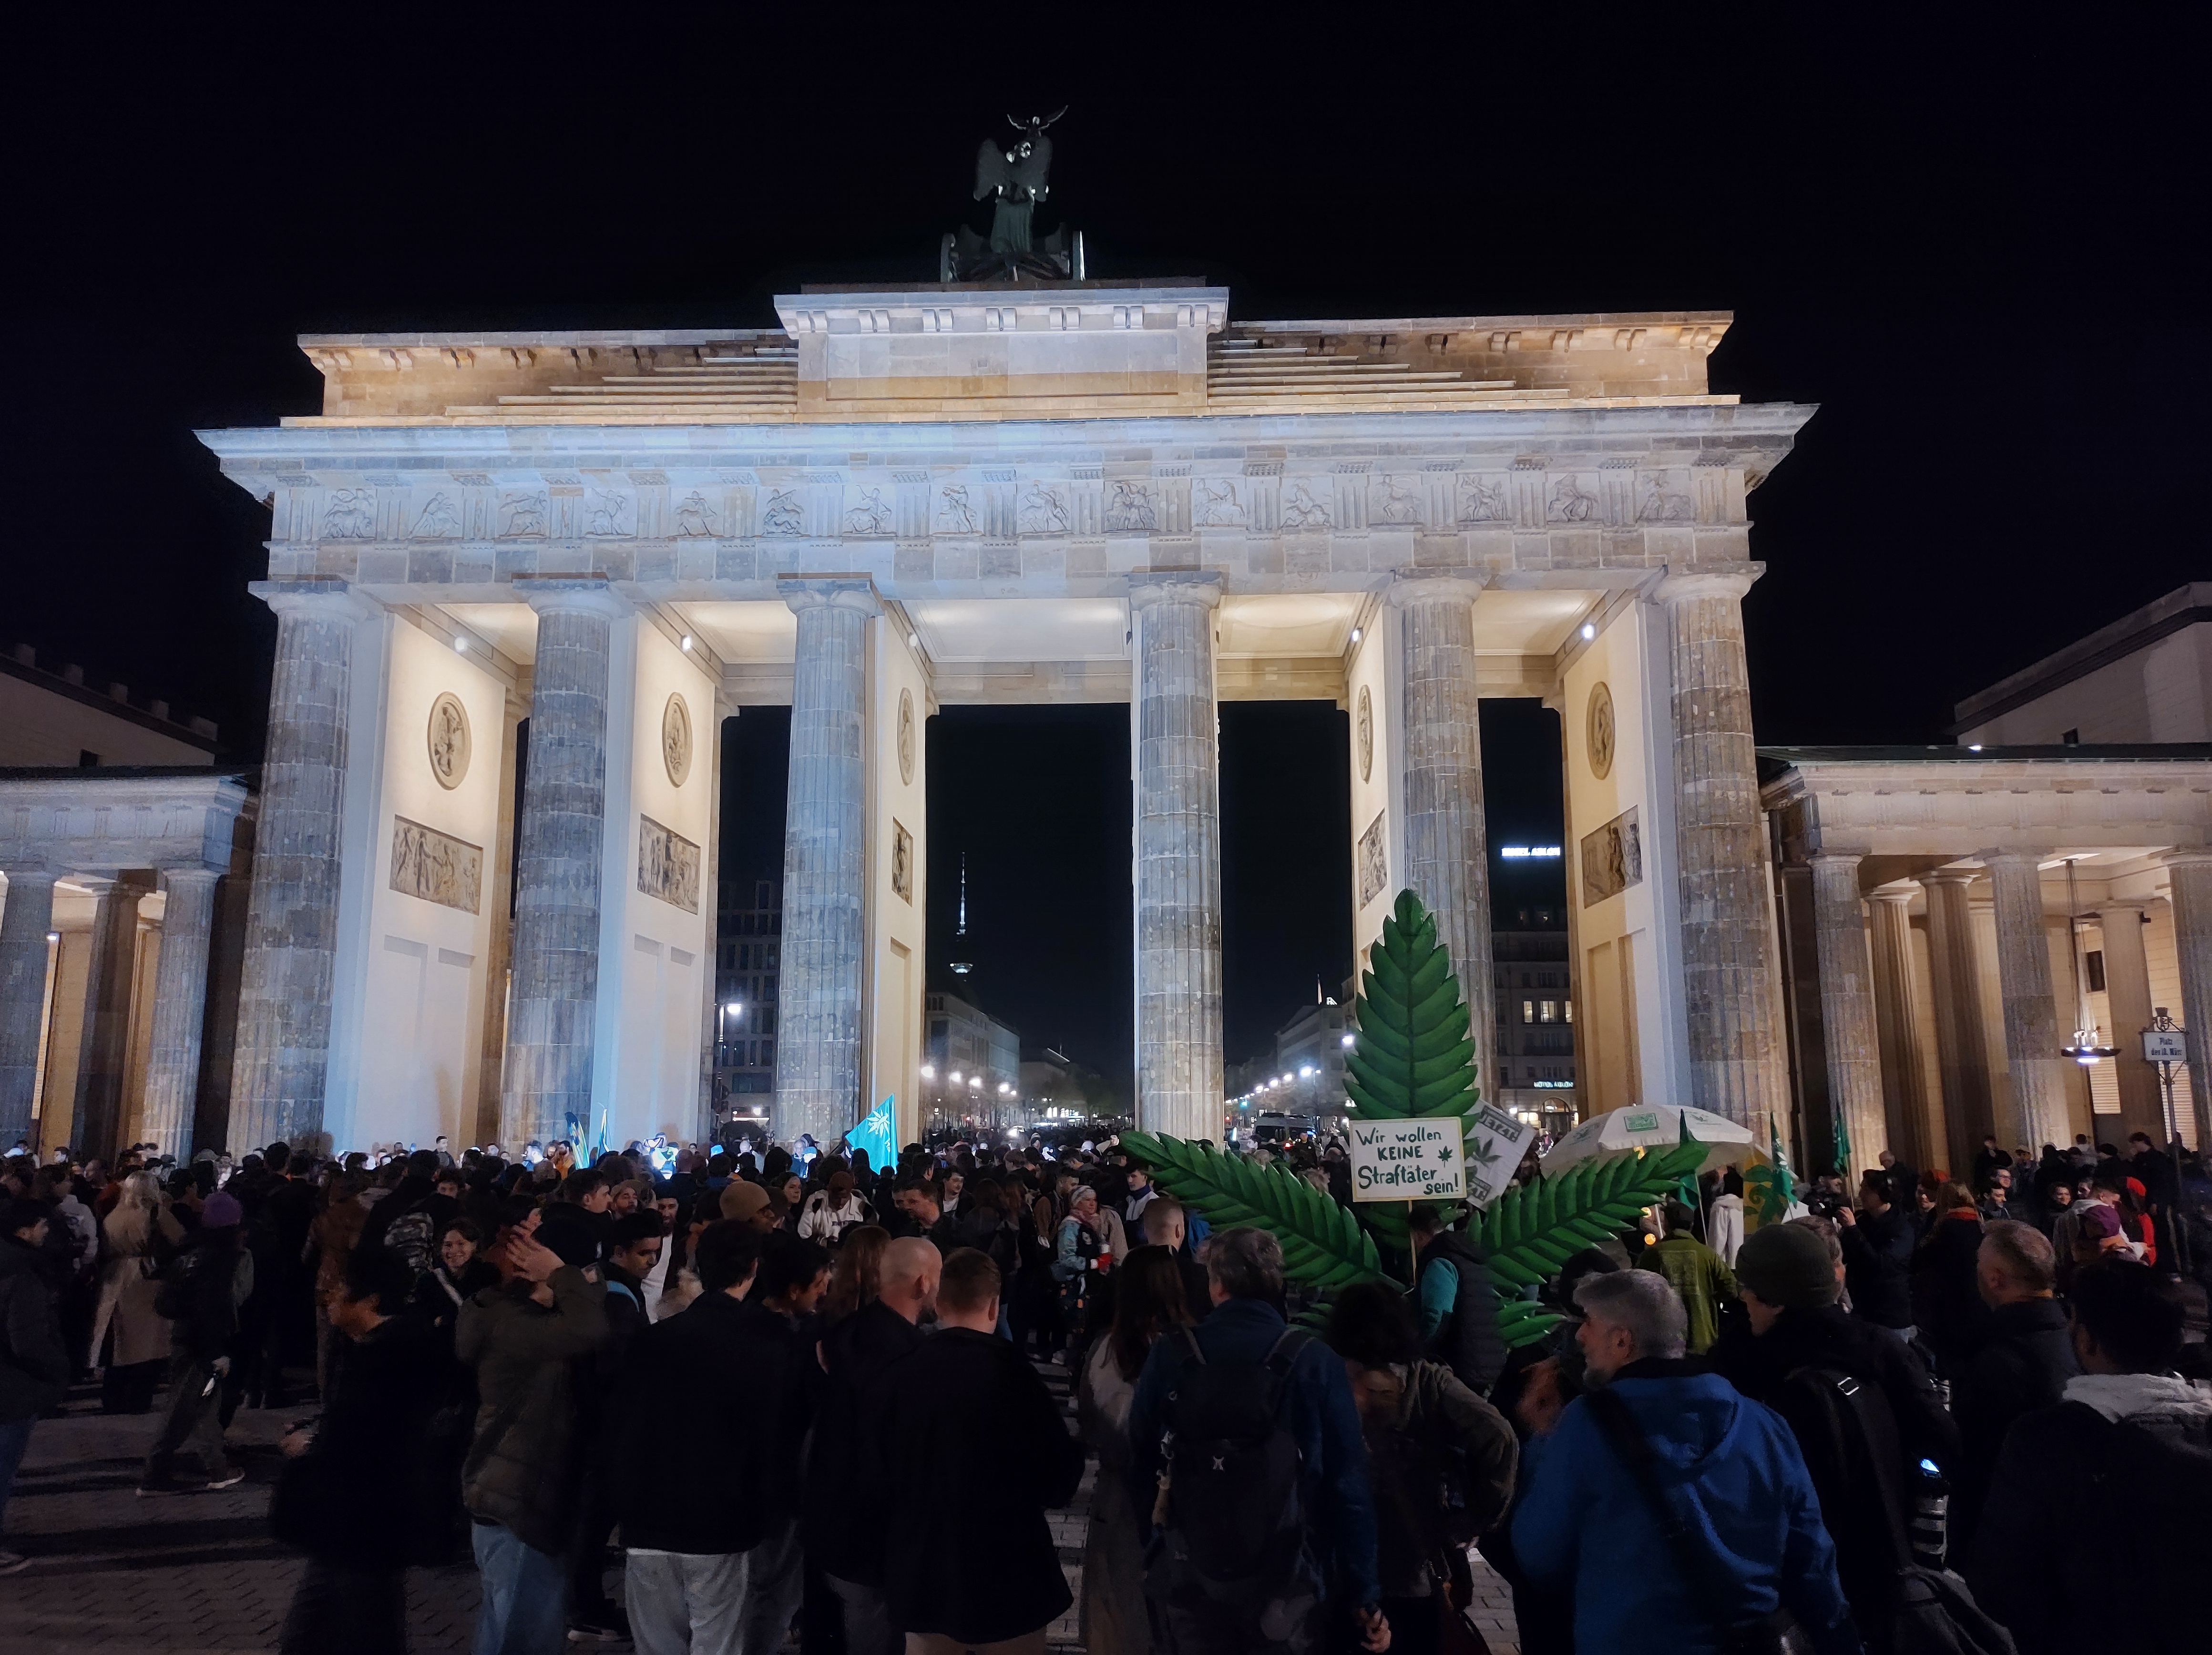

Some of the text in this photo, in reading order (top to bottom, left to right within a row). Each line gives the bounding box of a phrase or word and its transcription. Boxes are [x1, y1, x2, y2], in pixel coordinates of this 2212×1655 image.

[1355, 1126, 1442, 1145] Wir wollen
[1478, 1114, 1519, 1141] JETZT!
[1377, 1145, 1423, 1161] KEINE
[1358, 1164, 1437, 1189] Straftäter
[1423, 1173, 1459, 1195] sein!
